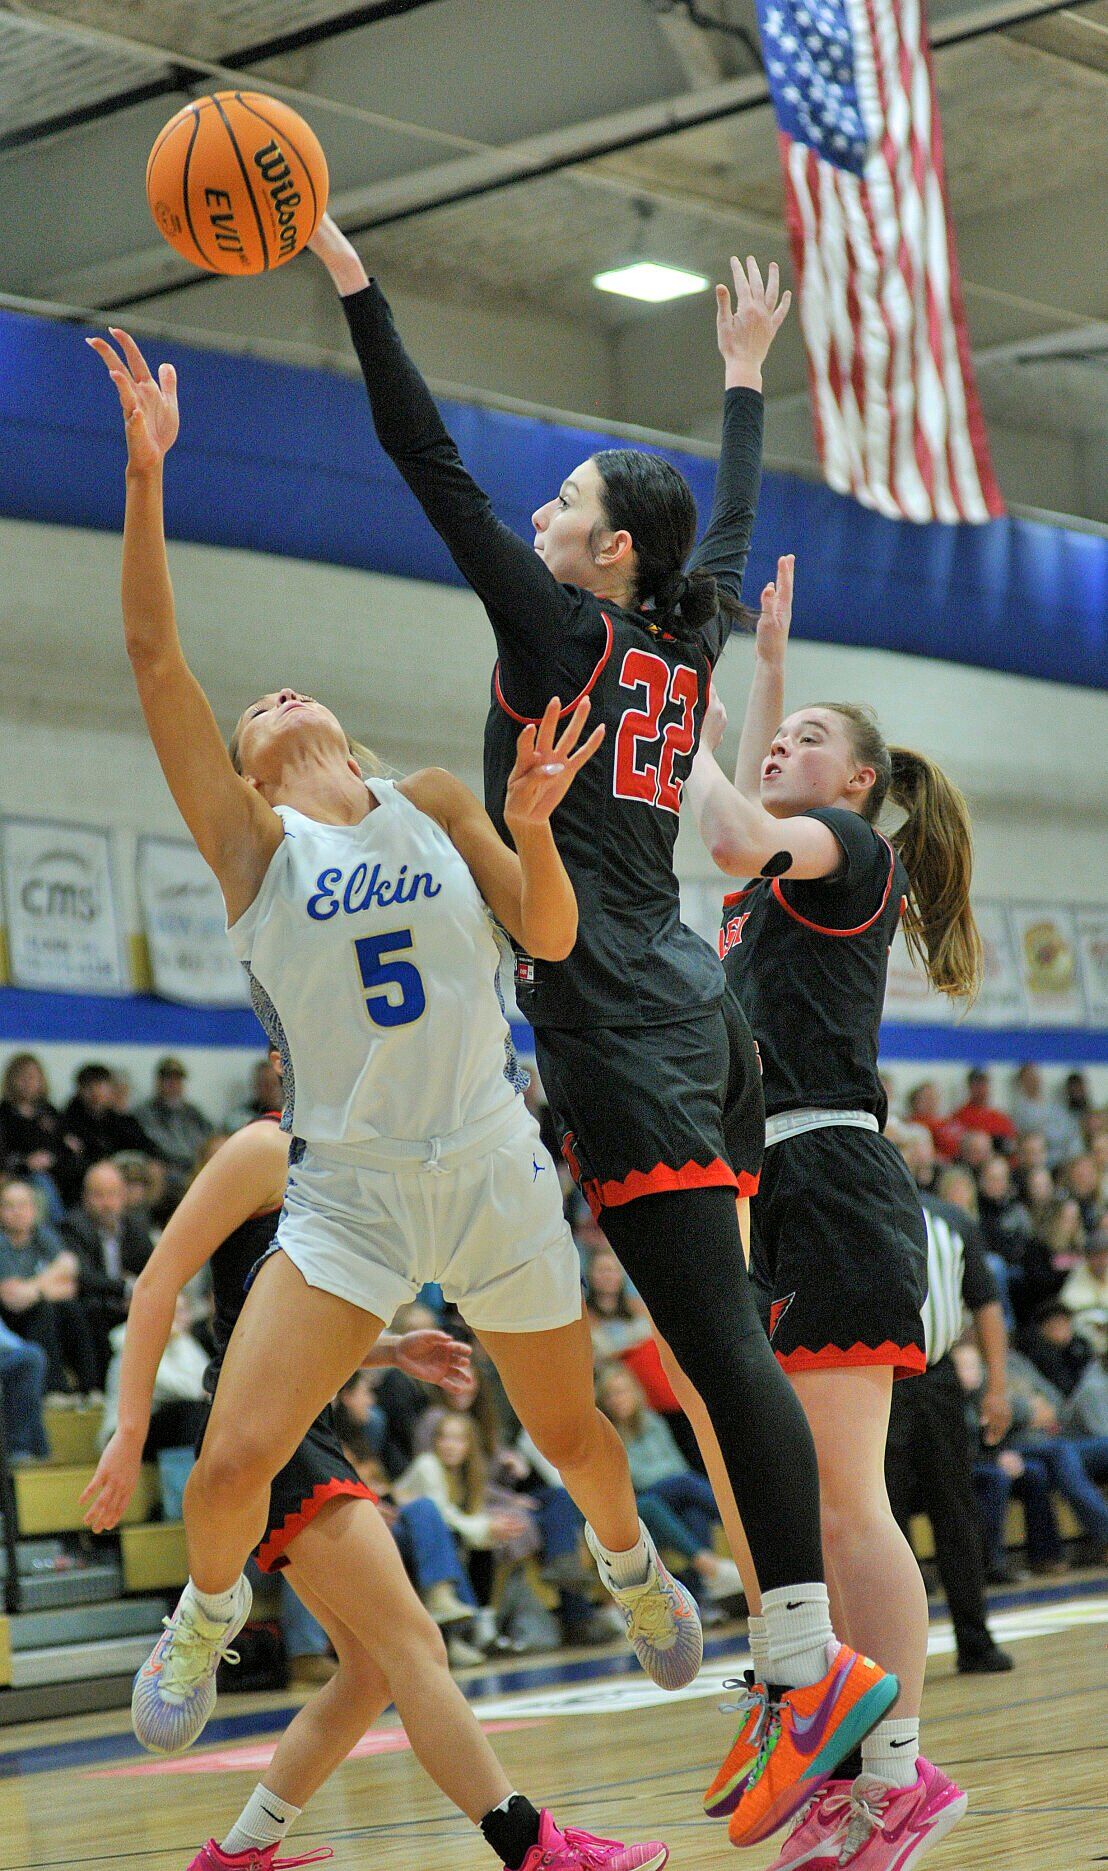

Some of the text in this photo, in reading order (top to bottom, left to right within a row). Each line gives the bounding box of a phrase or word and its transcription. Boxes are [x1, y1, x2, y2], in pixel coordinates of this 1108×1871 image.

[253, 138, 302, 261] Wilson
[612, 647, 699, 817] 22
[306, 862, 442, 921] Elkin
[352, 924, 430, 1031] 5
